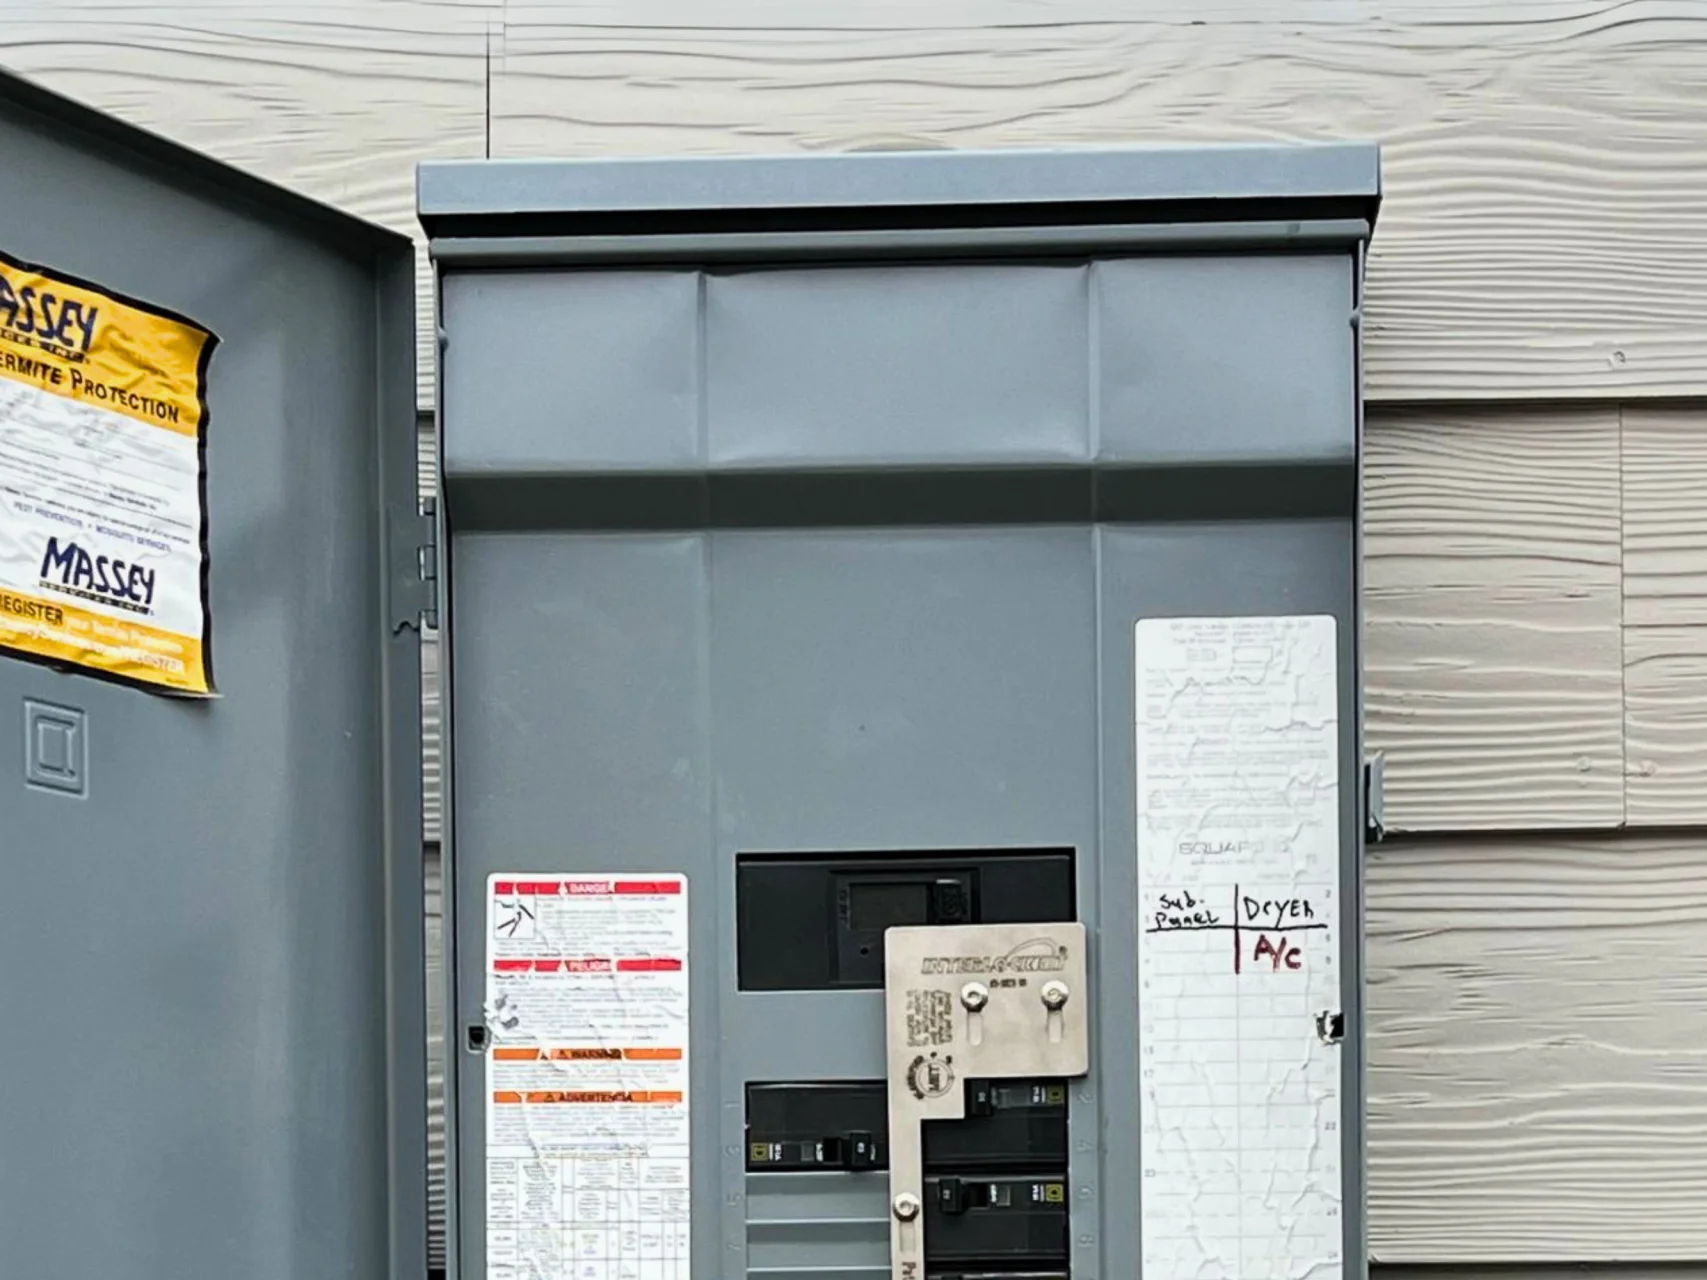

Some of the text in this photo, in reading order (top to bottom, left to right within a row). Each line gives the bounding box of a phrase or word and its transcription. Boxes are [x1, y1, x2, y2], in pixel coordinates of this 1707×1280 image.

[40, 536, 155, 605] MASSEY
[0, 593, 63, 626] EGISTER
[1254, 933, 1302, 973] A/C
